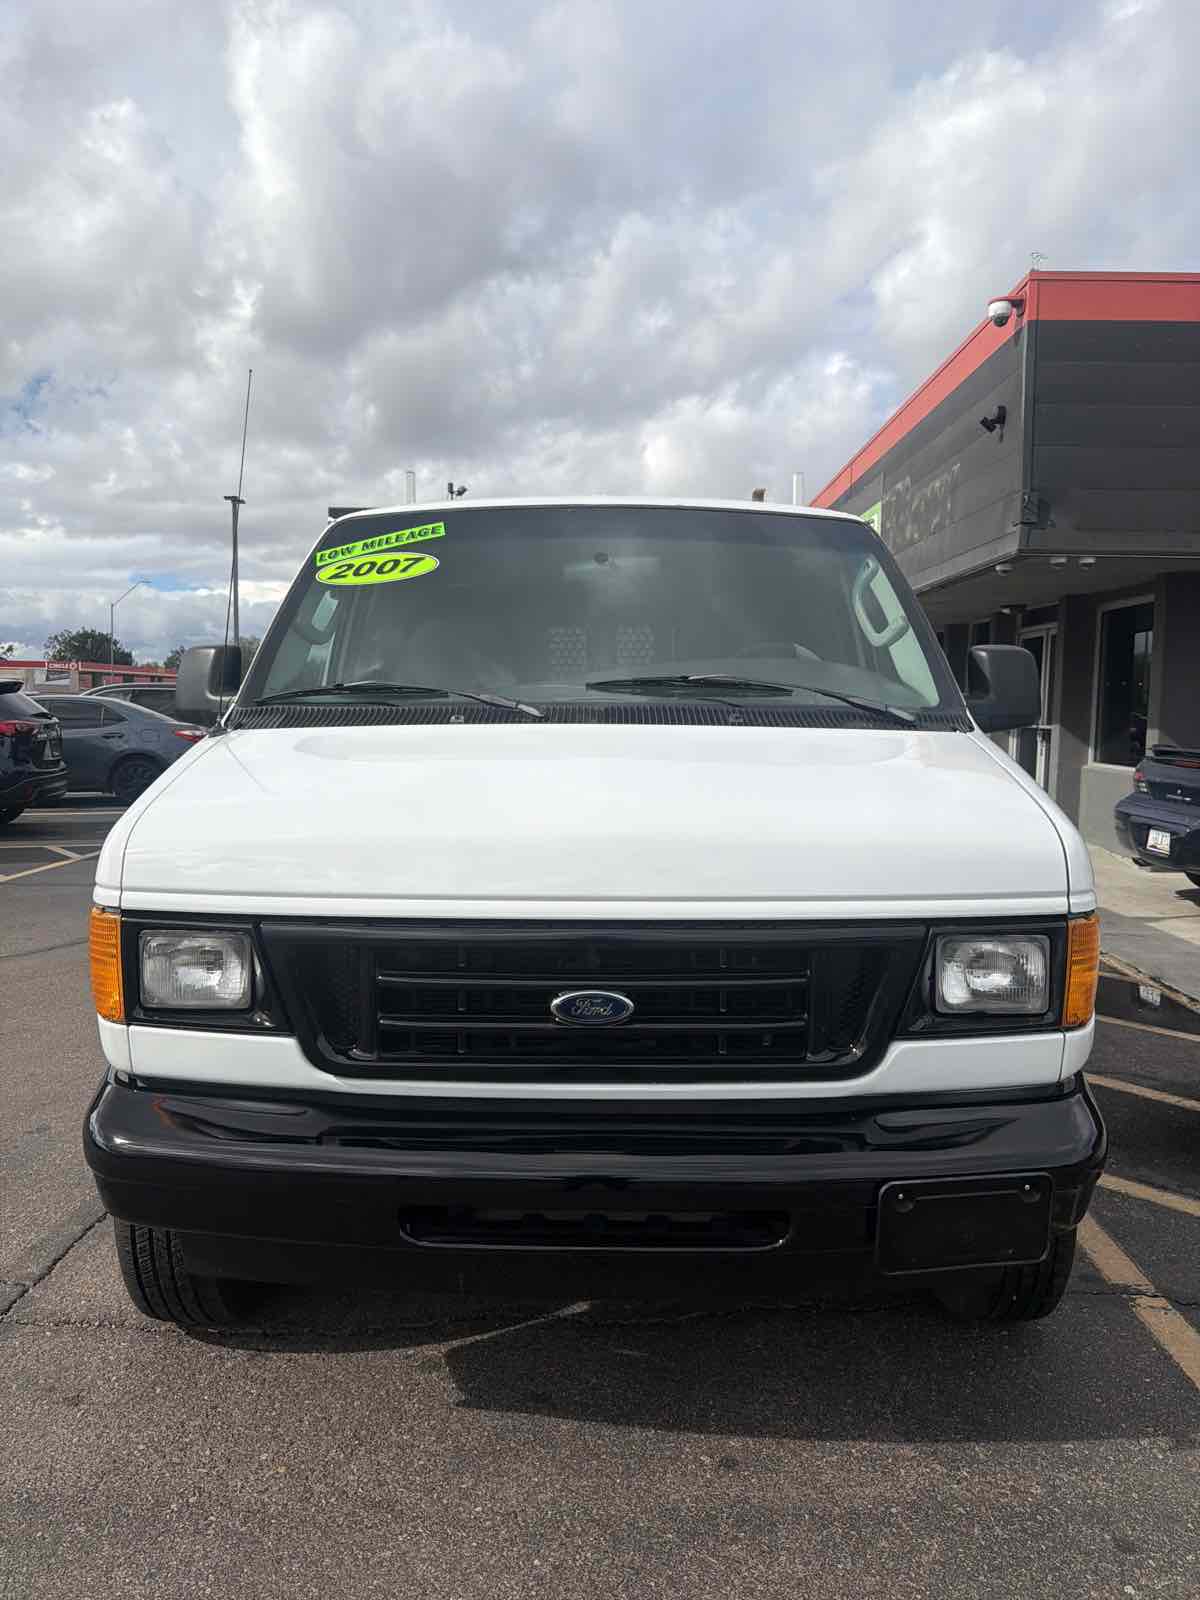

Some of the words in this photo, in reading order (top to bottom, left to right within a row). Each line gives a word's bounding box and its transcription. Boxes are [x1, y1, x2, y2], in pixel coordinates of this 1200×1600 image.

[319, 545, 353, 561] LOW
[361, 524, 443, 551] MILEAGE
[327, 557, 426, 579] 2007
[571, 998, 616, 1017] Ford
